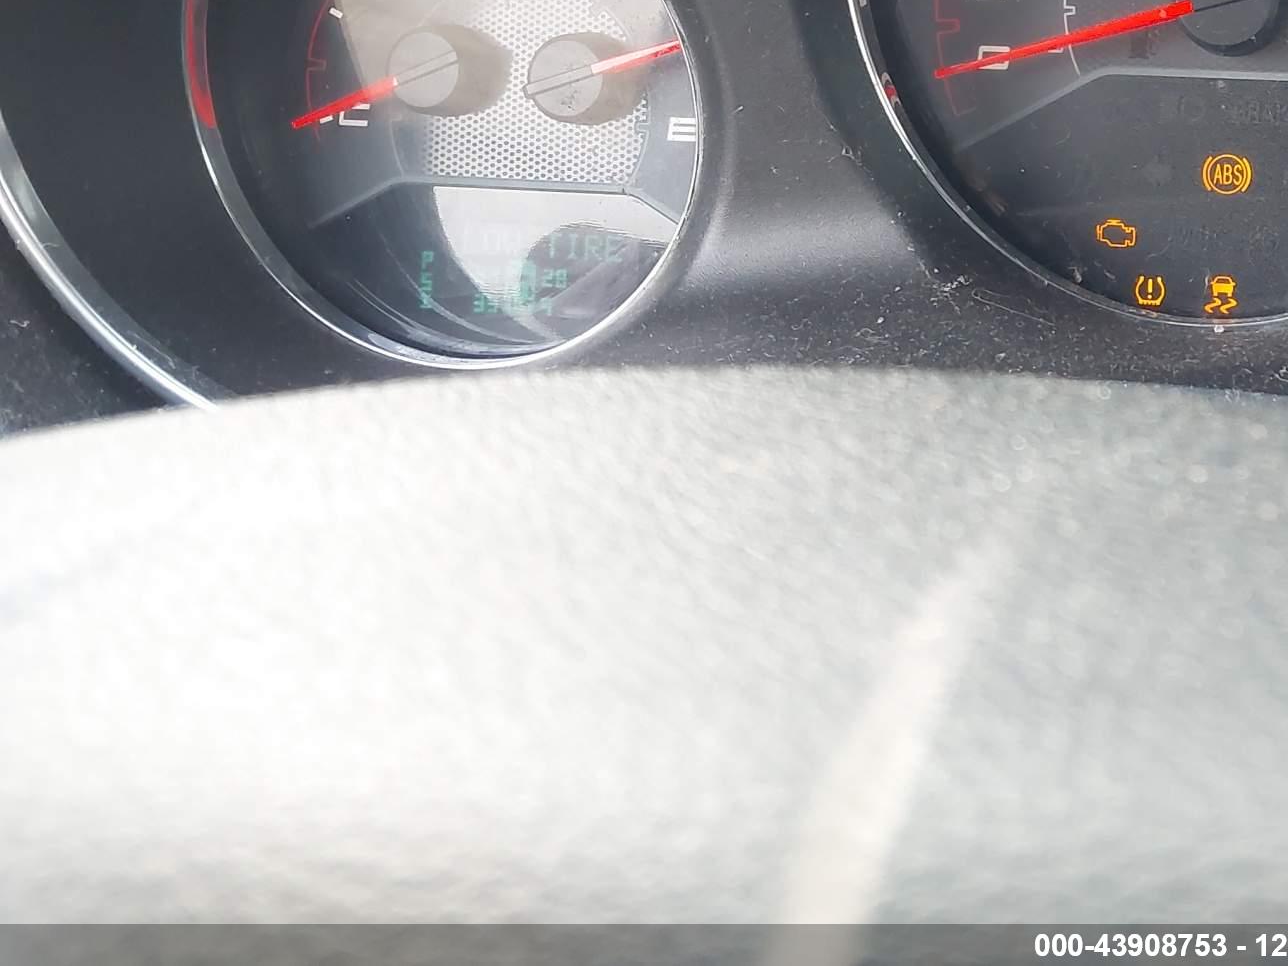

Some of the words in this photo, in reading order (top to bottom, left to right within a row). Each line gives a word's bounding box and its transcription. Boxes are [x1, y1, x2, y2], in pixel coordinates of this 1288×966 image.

[978, 45, 1010, 70] 0
[667, 117, 697, 142] E
[1213, 163, 1242, 185] ABS
[550, 234, 623, 262] TIRE
